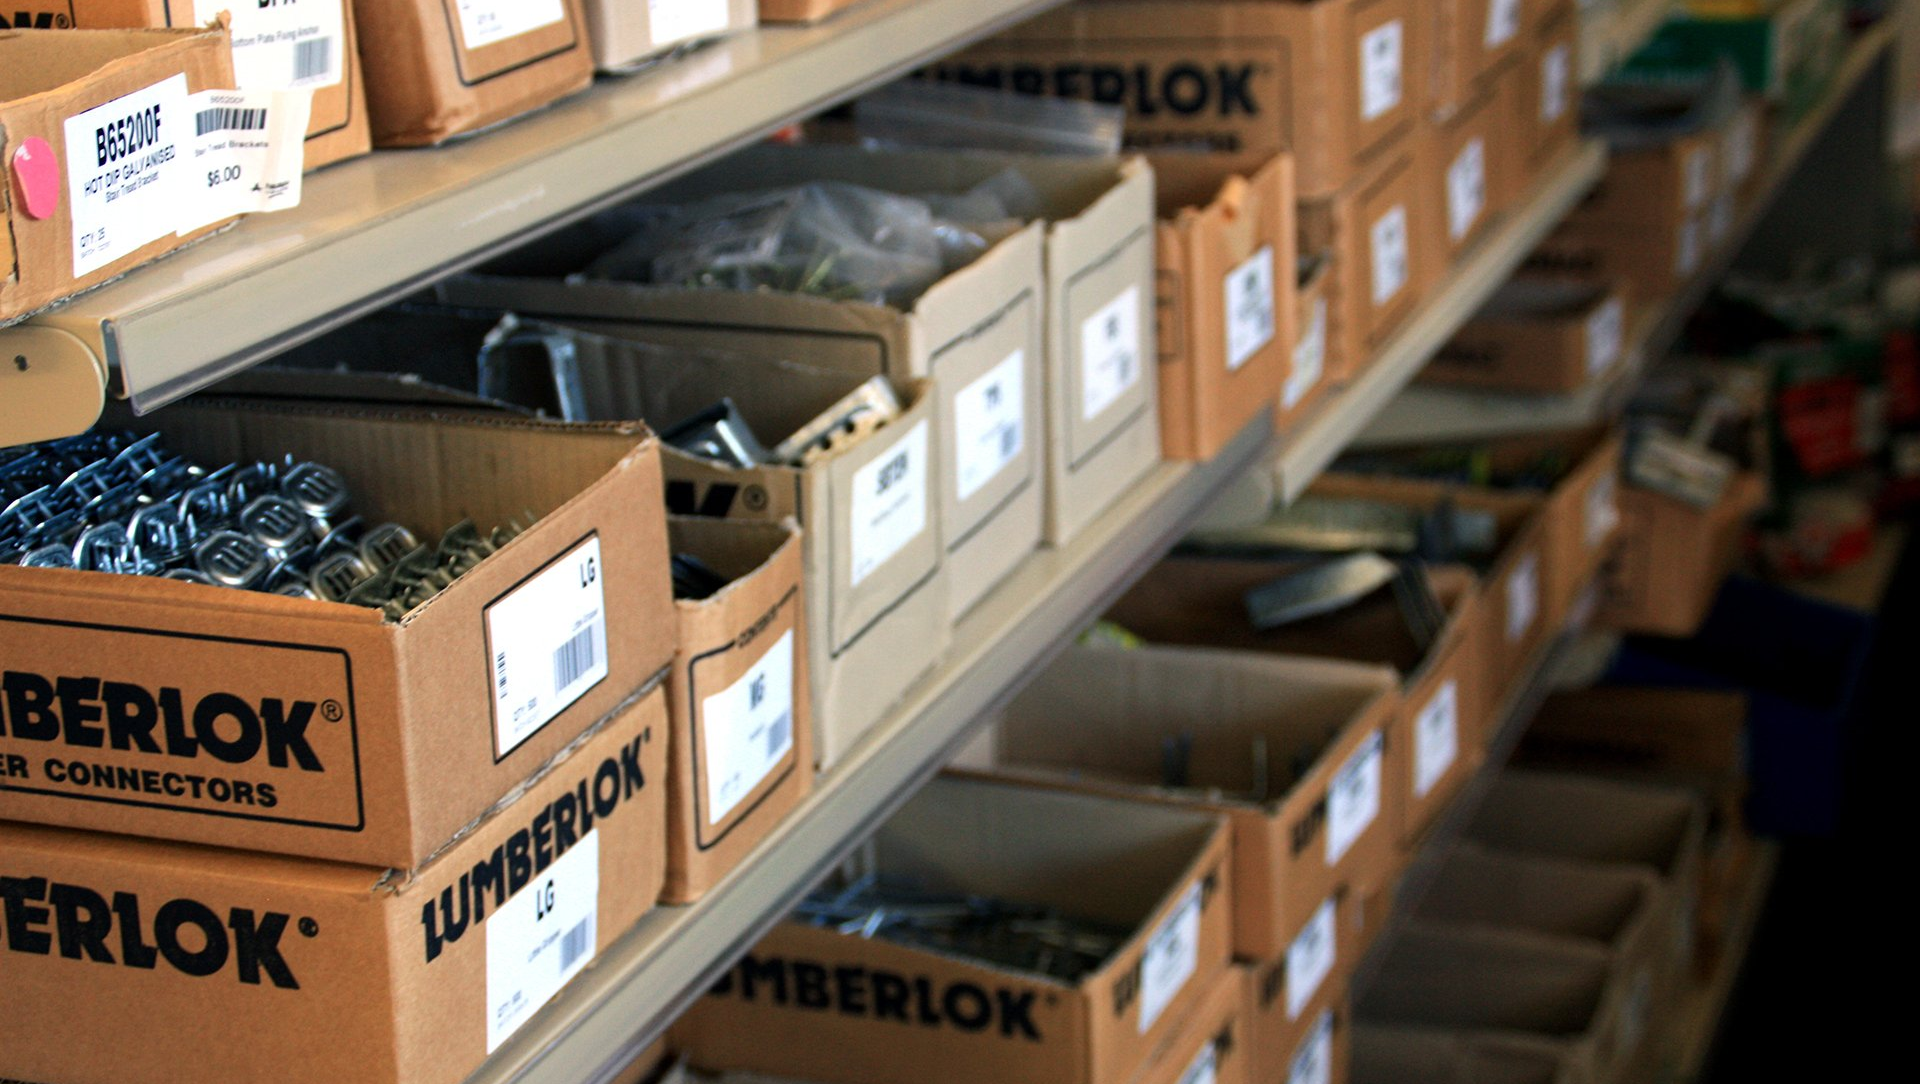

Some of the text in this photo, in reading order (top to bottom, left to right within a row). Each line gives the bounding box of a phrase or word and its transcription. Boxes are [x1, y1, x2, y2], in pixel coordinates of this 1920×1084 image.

[96, 104, 161, 168] B65200F
[228, 140, 270, 149] Brackets
[84, 145, 176, 197] HOT DIP GALVANISED
[207, 165, 242, 188] $6.00
[579, 556, 597, 589] LG
[0, 671, 325, 773] BERLOK
[44, 758, 279, 808] CONNECTORS
[421, 733, 646, 965] LUMBERLOK
[536, 879, 555, 922] LG
[0, 876, 301, 990] ERLOK
